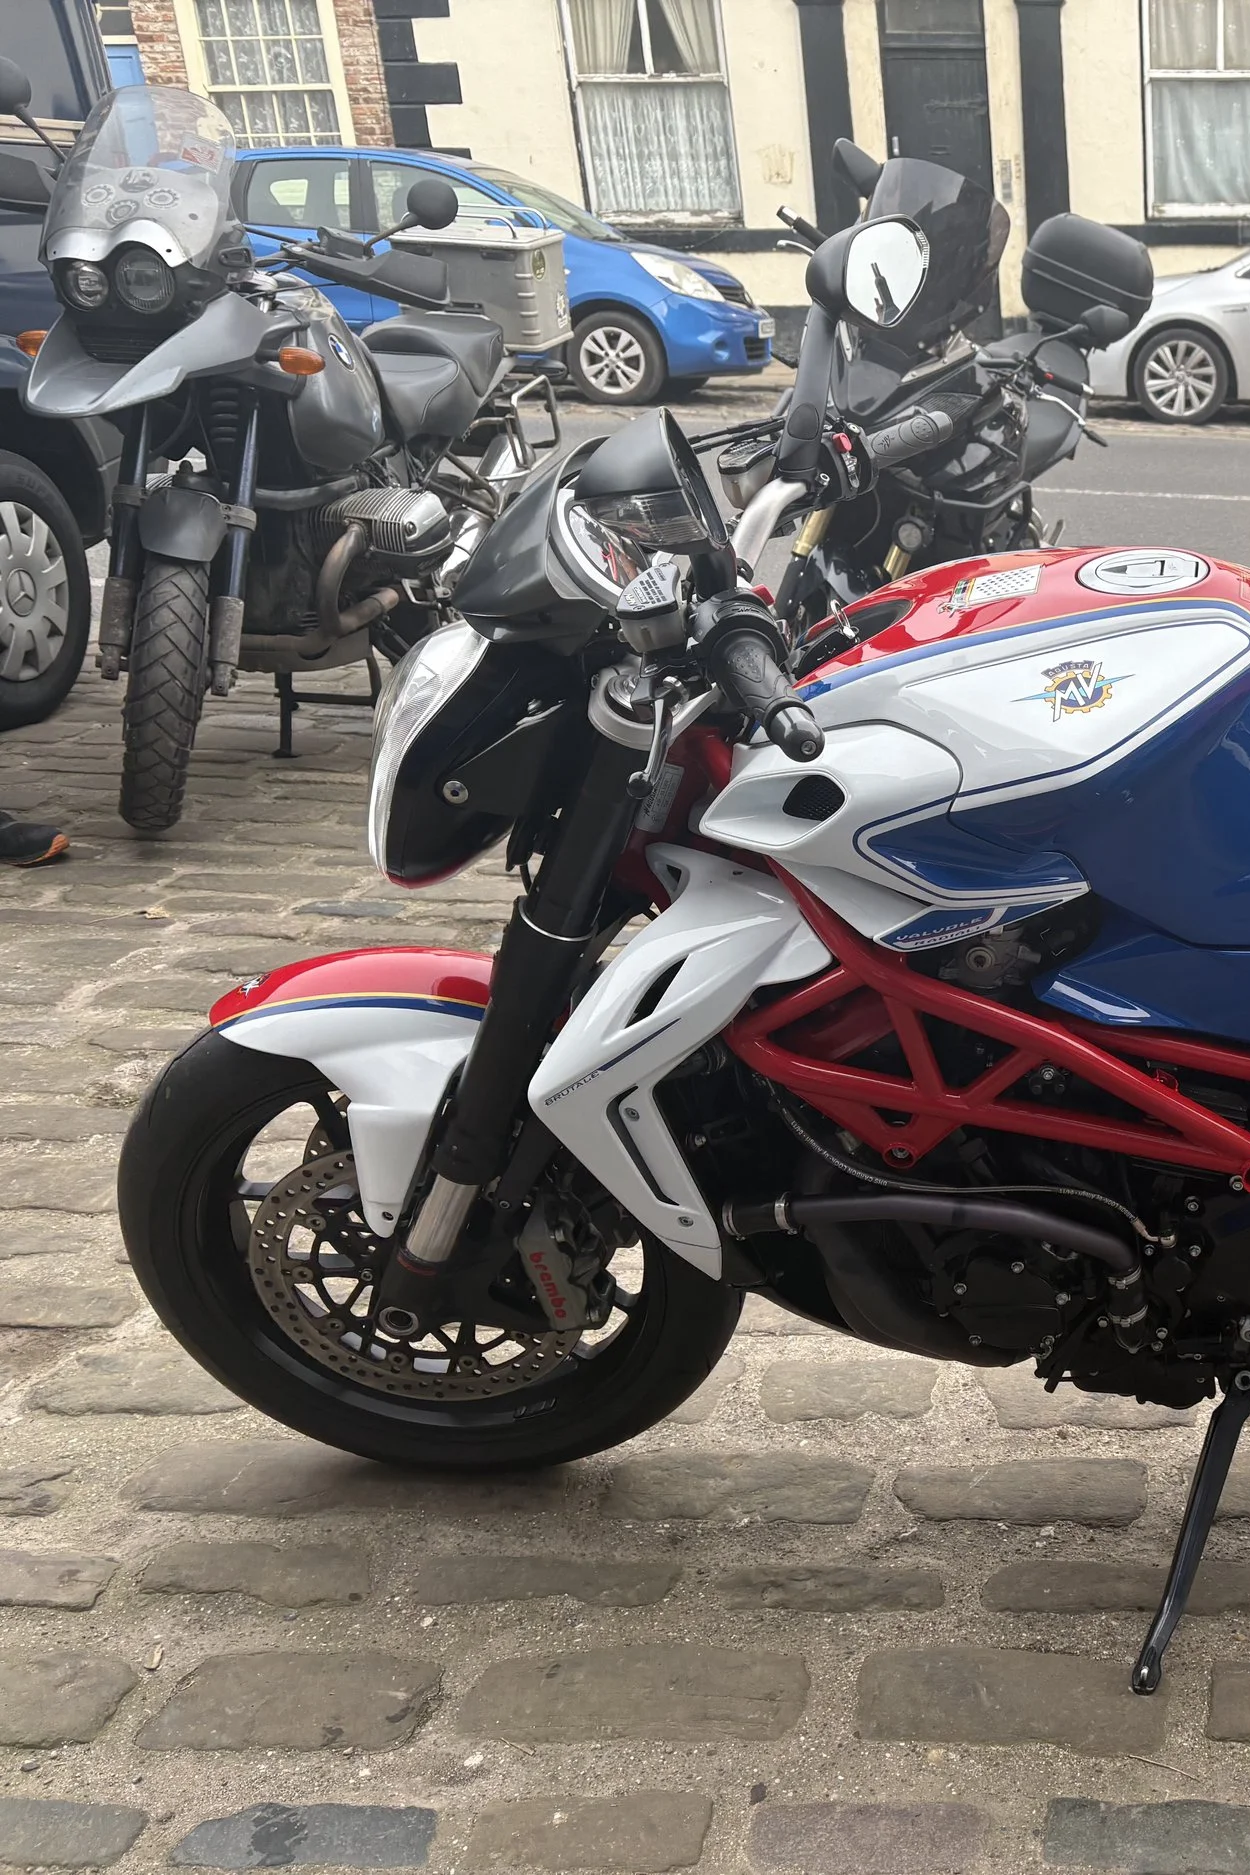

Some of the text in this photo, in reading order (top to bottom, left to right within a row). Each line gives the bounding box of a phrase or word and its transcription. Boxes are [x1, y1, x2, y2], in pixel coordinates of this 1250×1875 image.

[1048, 662, 1090, 677] AGUSTA
[1052, 661, 1103, 722] MV
[896, 915, 984, 941] VALVOLE
[914, 925, 981, 946] RADIALI
[544, 1070, 600, 1107] BRUTALE
[528, 1250, 568, 1319] brembo
